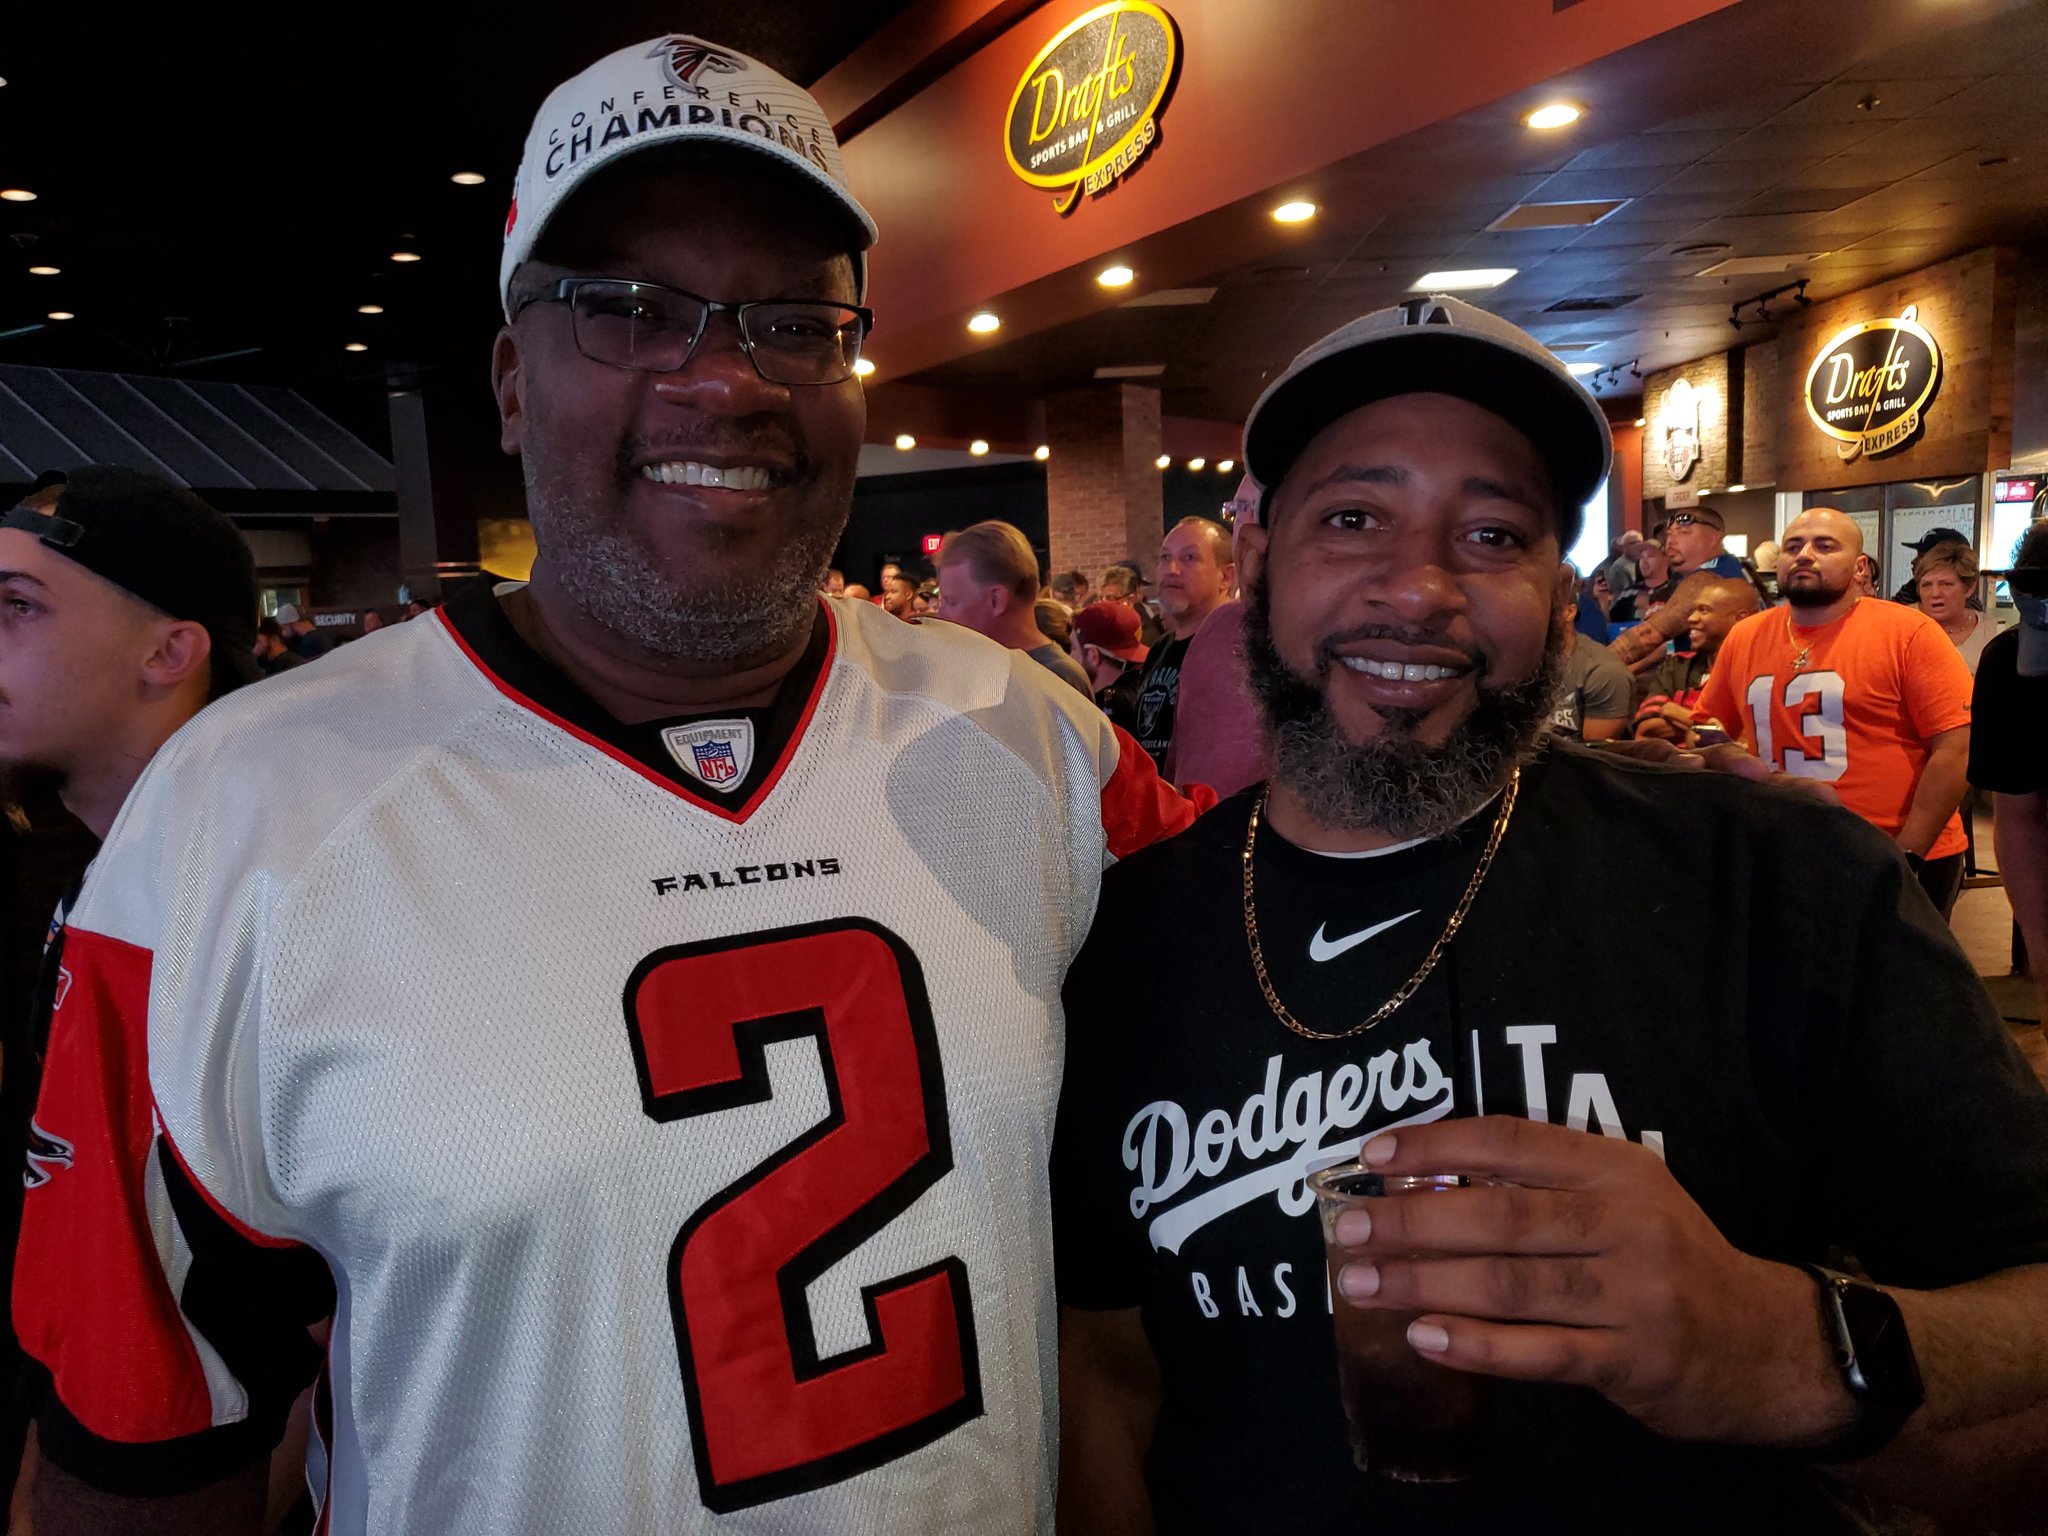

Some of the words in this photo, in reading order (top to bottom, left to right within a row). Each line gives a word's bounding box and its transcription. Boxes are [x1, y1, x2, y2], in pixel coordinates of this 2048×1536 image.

[549, 86, 820, 146] CONFERENCE
[1029, 12, 1136, 165] Drafts
[545, 104, 830, 179] CHAMPIONS
[1031, 141, 1067, 169] SPORTS
[1068, 128, 1090, 153] BAR
[1096, 120, 1105, 134] &
[1106, 103, 1138, 128] GRILL
[1086, 120, 1156, 193] EXPRESS
[1827, 407, 1853, 422] SPORTS
[1854, 403, 1870, 416] BAR
[1876, 402, 1882, 412] &
[1883, 397, 1906, 411] GRILL
[1865, 413, 1917, 451] EXPRESS
[315, 613, 356, 626] SECURITY
[674, 729, 743, 746] EQUIPMENT
[1747, 669, 1848, 782] 13
[700, 757, 735, 780] NFL
[652, 858, 841, 895] FALCONS
[1123, 1038, 1453, 1219] Dodgers
[622, 915, 985, 1516] 2
[1192, 1263, 1333, 1318] BAS
